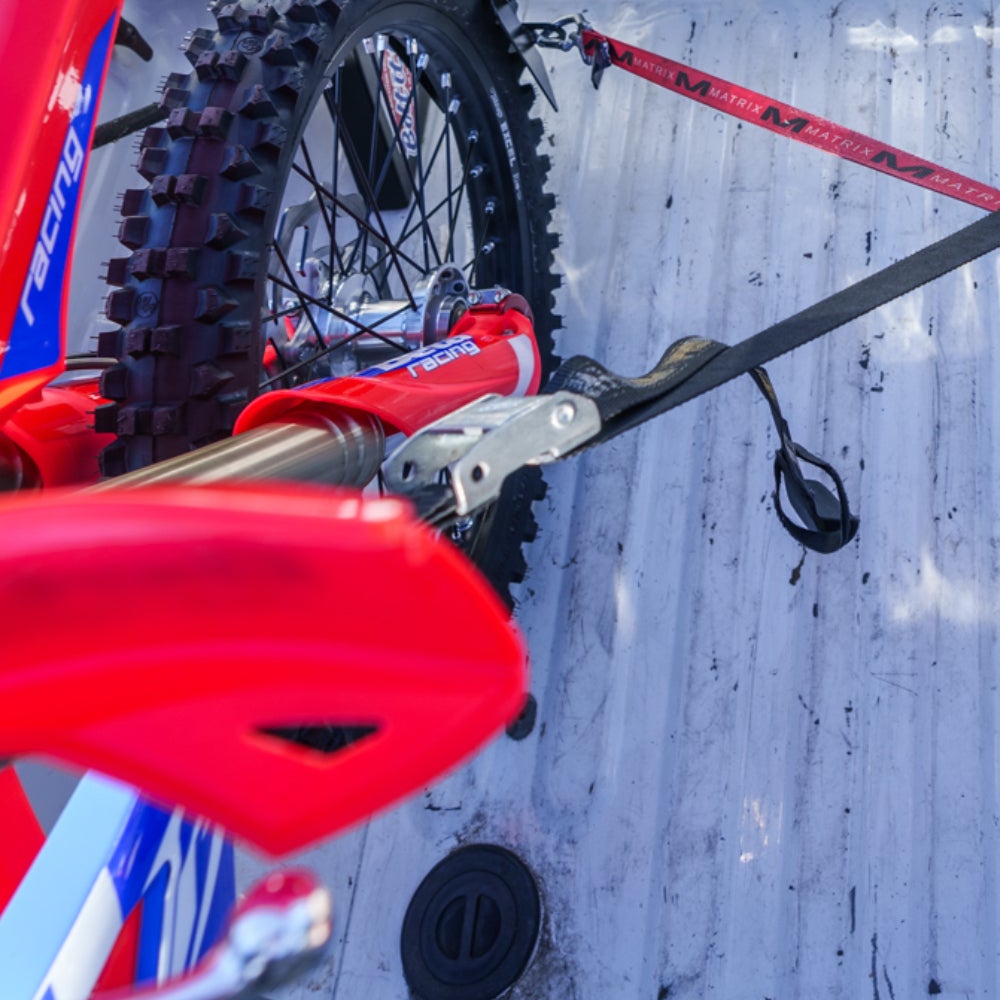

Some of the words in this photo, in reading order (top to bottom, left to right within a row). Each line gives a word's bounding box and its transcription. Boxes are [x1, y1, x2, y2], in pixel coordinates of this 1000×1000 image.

[632, 56, 675, 80] MATRIX
[708, 87, 763, 115] MATRIX
[804, 125, 874, 157] MATRIX
[20, 124, 85, 327] racing
[406, 340, 481, 378] racing
